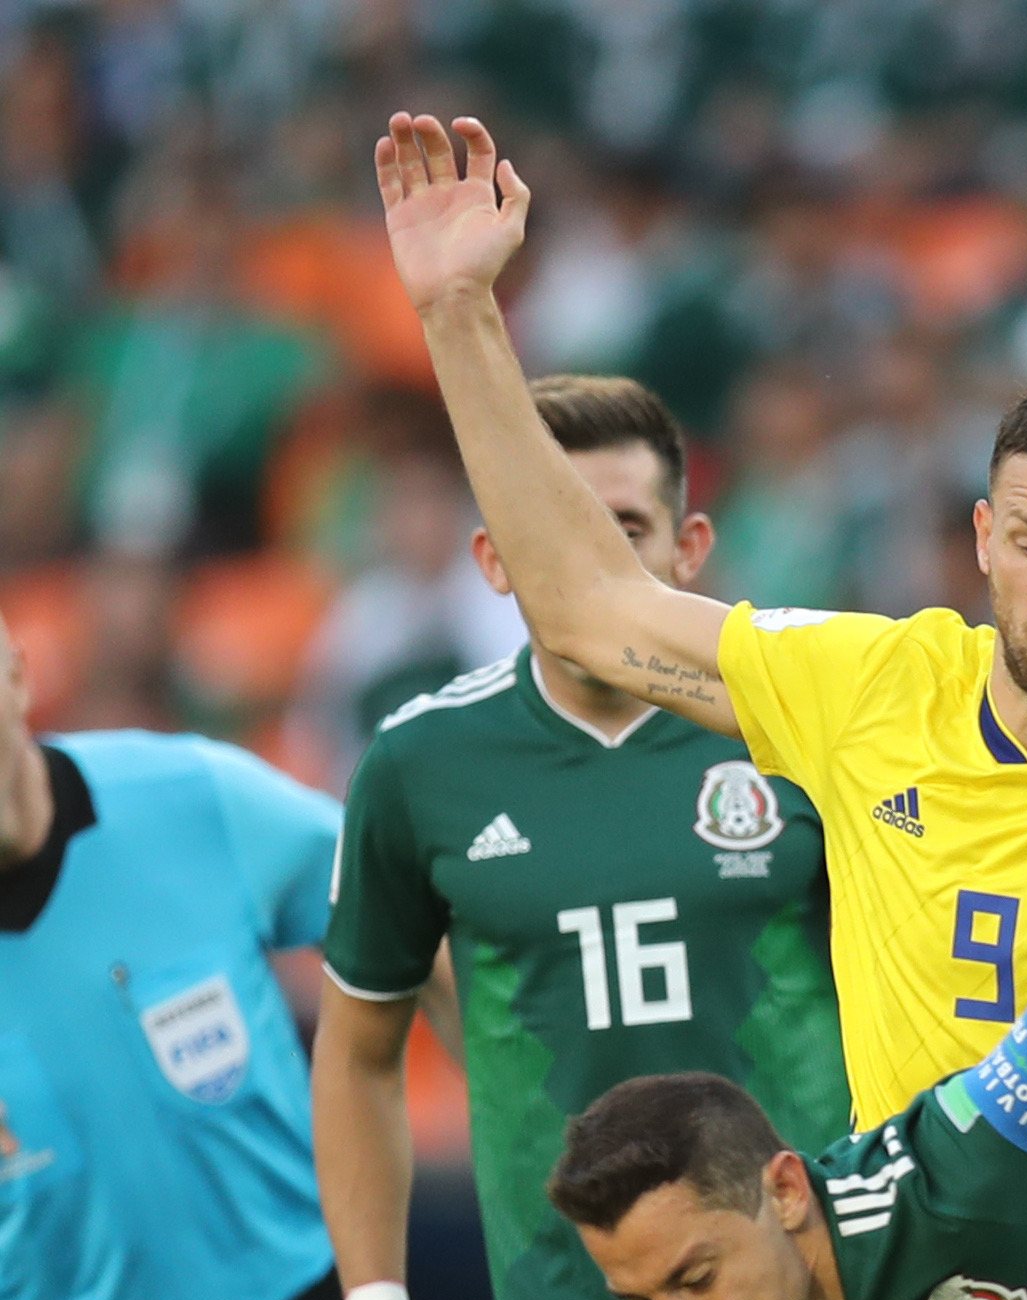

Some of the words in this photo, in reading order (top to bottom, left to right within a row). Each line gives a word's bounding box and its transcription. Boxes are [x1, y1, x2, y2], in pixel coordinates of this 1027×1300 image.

[872, 805, 925, 838] adidas
[557, 897, 693, 1031] 16
[952, 889, 1021, 1024] 9
